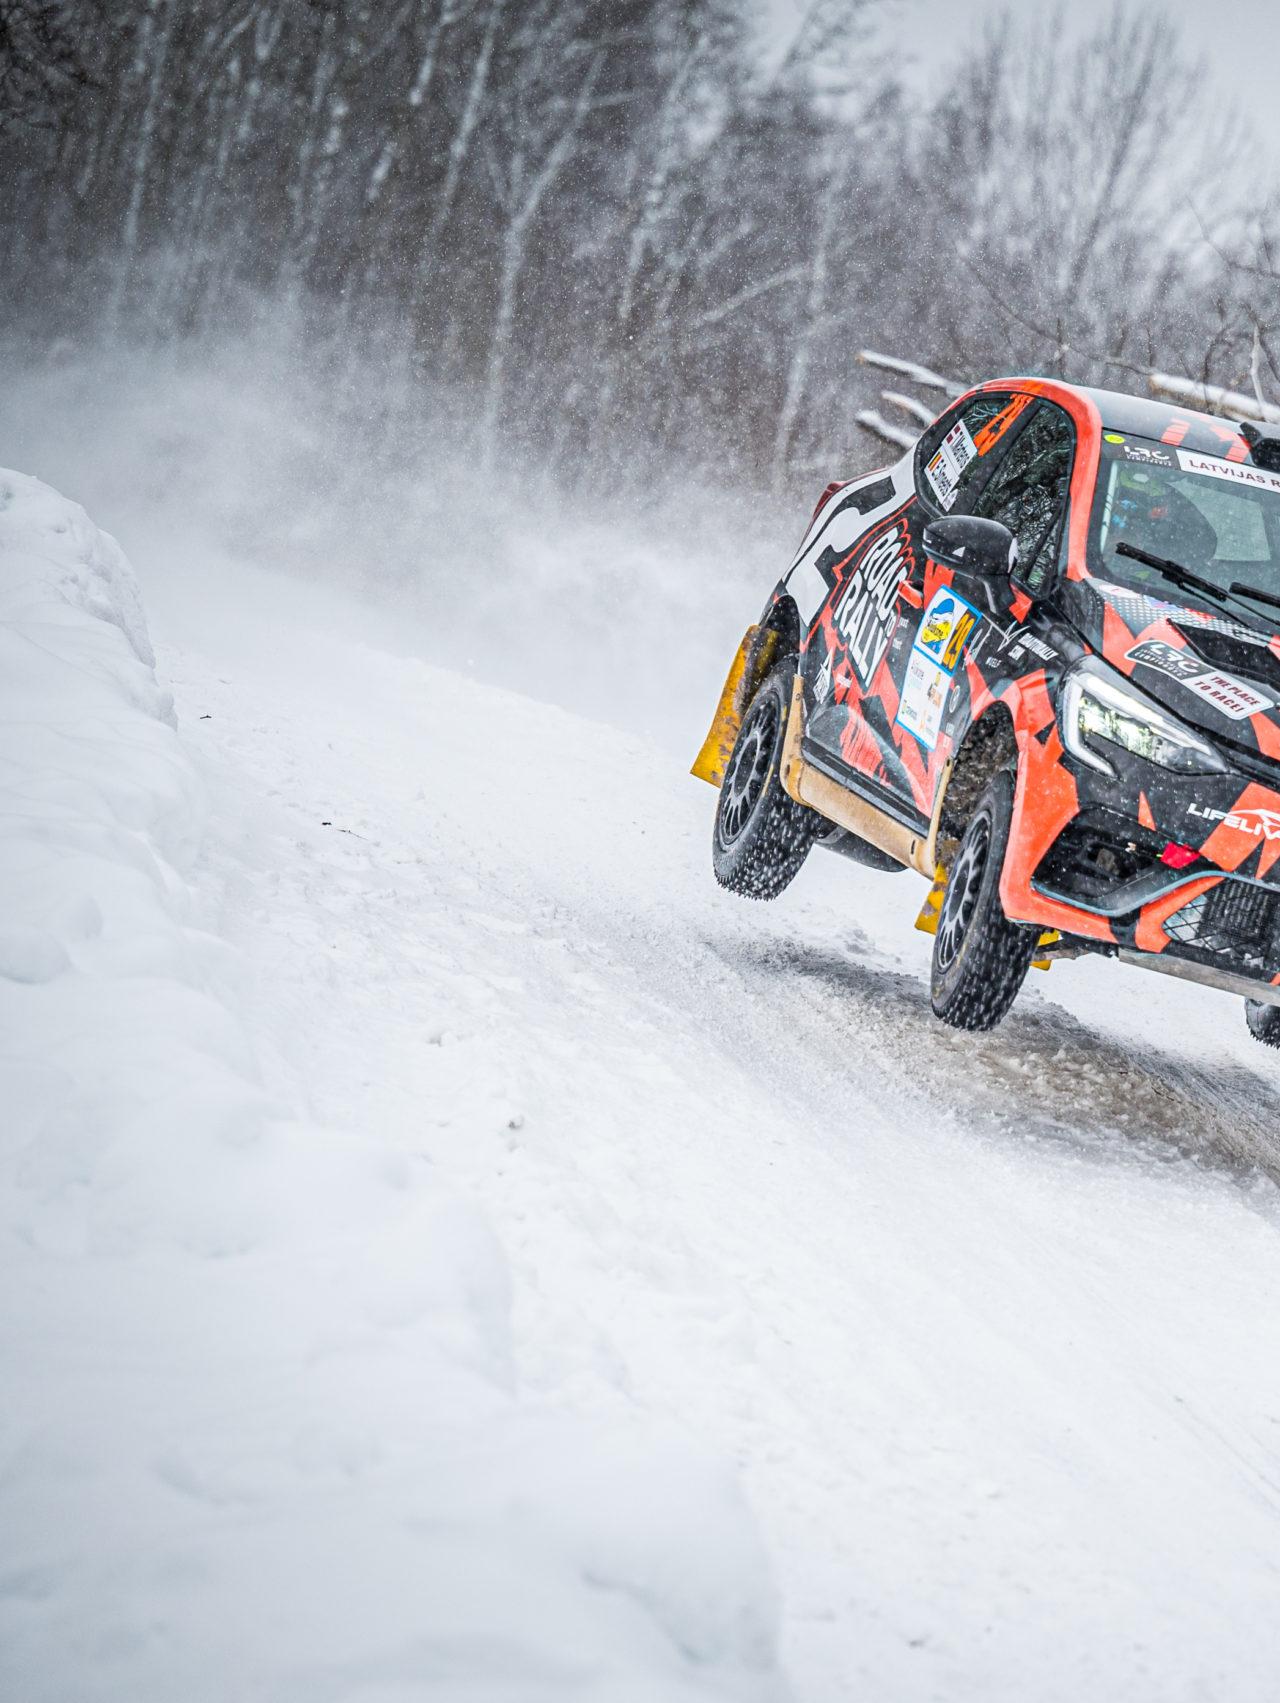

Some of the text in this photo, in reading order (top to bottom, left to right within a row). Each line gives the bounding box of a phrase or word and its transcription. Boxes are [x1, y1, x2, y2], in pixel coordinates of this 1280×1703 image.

[1189, 459, 1266, 484] LATVIJAS
[860, 527, 908, 621] ROAD
[834, 569, 889, 688] RALLY
[942, 612, 975, 670] 29
[1194, 681, 1245, 713] TO RACE!
[1210, 676, 1261, 706] THE PLACE
